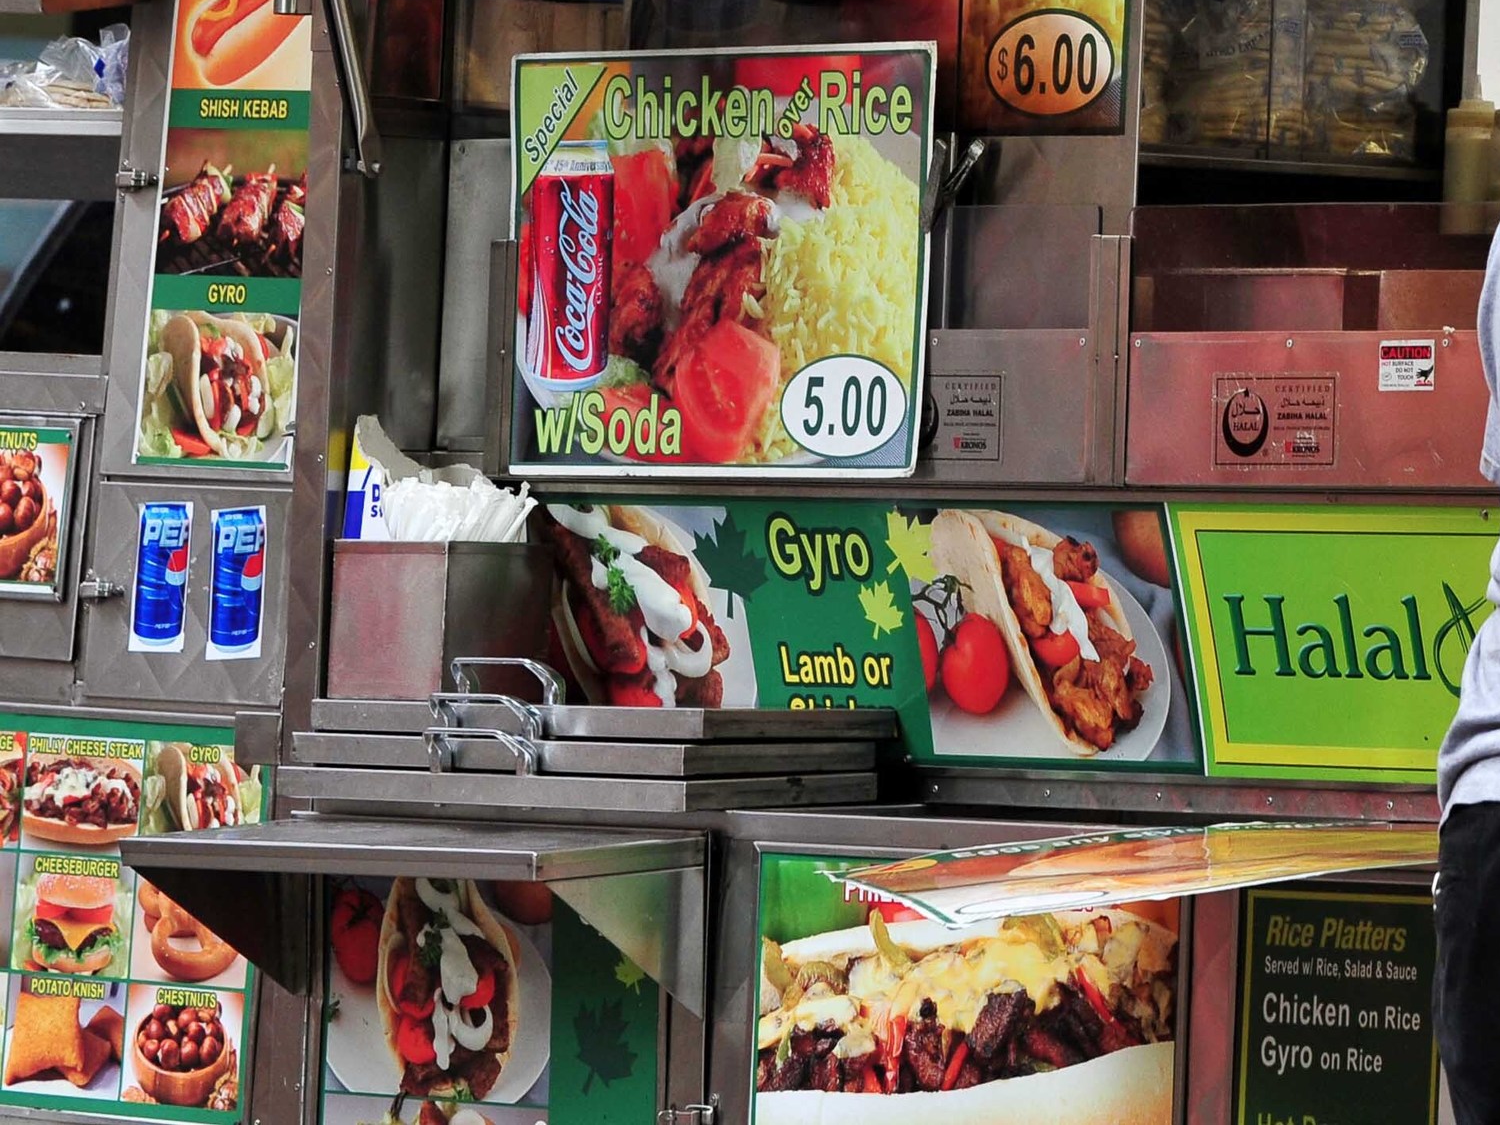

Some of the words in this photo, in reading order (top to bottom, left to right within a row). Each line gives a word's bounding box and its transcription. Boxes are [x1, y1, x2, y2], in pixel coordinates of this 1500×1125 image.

[996, 31, 1098, 98] $6.00
[200, 98, 240, 119] SHISH
[243, 99, 289, 120] KEBAB
[524, 64, 581, 165] Special
[602, 73, 775, 141] Chicken
[777, 76, 816, 140] over
[818, 69, 914, 136] Rice
[553, 177, 600, 375] Coca-Cola
[594, 254, 605, 306] CLASSIC
[208, 283, 246, 305] GYRO
[1380, 345, 1432, 360] CAUTION
[1274, 384, 1331, 393] CERTIFIED
[802, 375, 889, 439] 5.00
[1304, 412, 1328, 421] HALAL
[533, 392, 683, 458] w/Soda
[1232, 420, 1260, 432] HALAL
[0, 431, 38, 452] TNUTS
[767, 515, 871, 593] Gyro
[1222, 590, 1432, 682] Halal
[780, 645, 856, 686] Lamb
[863, 654, 892, 686] or
[0, 734, 14, 753] GE
[29, 736, 64, 757] PHILLY
[65, 739, 108, 758] CHEESE
[109, 741, 144, 760] STEAK
[189, 746, 221, 765] GYRO
[35, 855, 119, 879] CHEESEBURGER
[1266, 914, 1315, 948] Rice
[1320, 916, 1408, 952] Platters
[1264, 955, 1300, 974] Served
[1301, 958, 1314, 975] w/
[1316, 957, 1341, 979] Rice,
[1344, 958, 1373, 979] Salad
[1375, 960, 1384, 979] &
[1385, 960, 1418, 980] Sauce
[31, 978, 72, 997] POTATO
[72, 980, 105, 999] KNISH
[156, 988, 217, 1009] CHESTNUTS
[1262, 991, 1350, 1027] Chicken
[1358, 1009, 1379, 1029] on
[1385, 1005, 1421, 1031] Rice
[1260, 1035, 1313, 1075] Gyro
[1320, 1050, 1341, 1070] on
[1346, 1047, 1383, 1073] Rice
